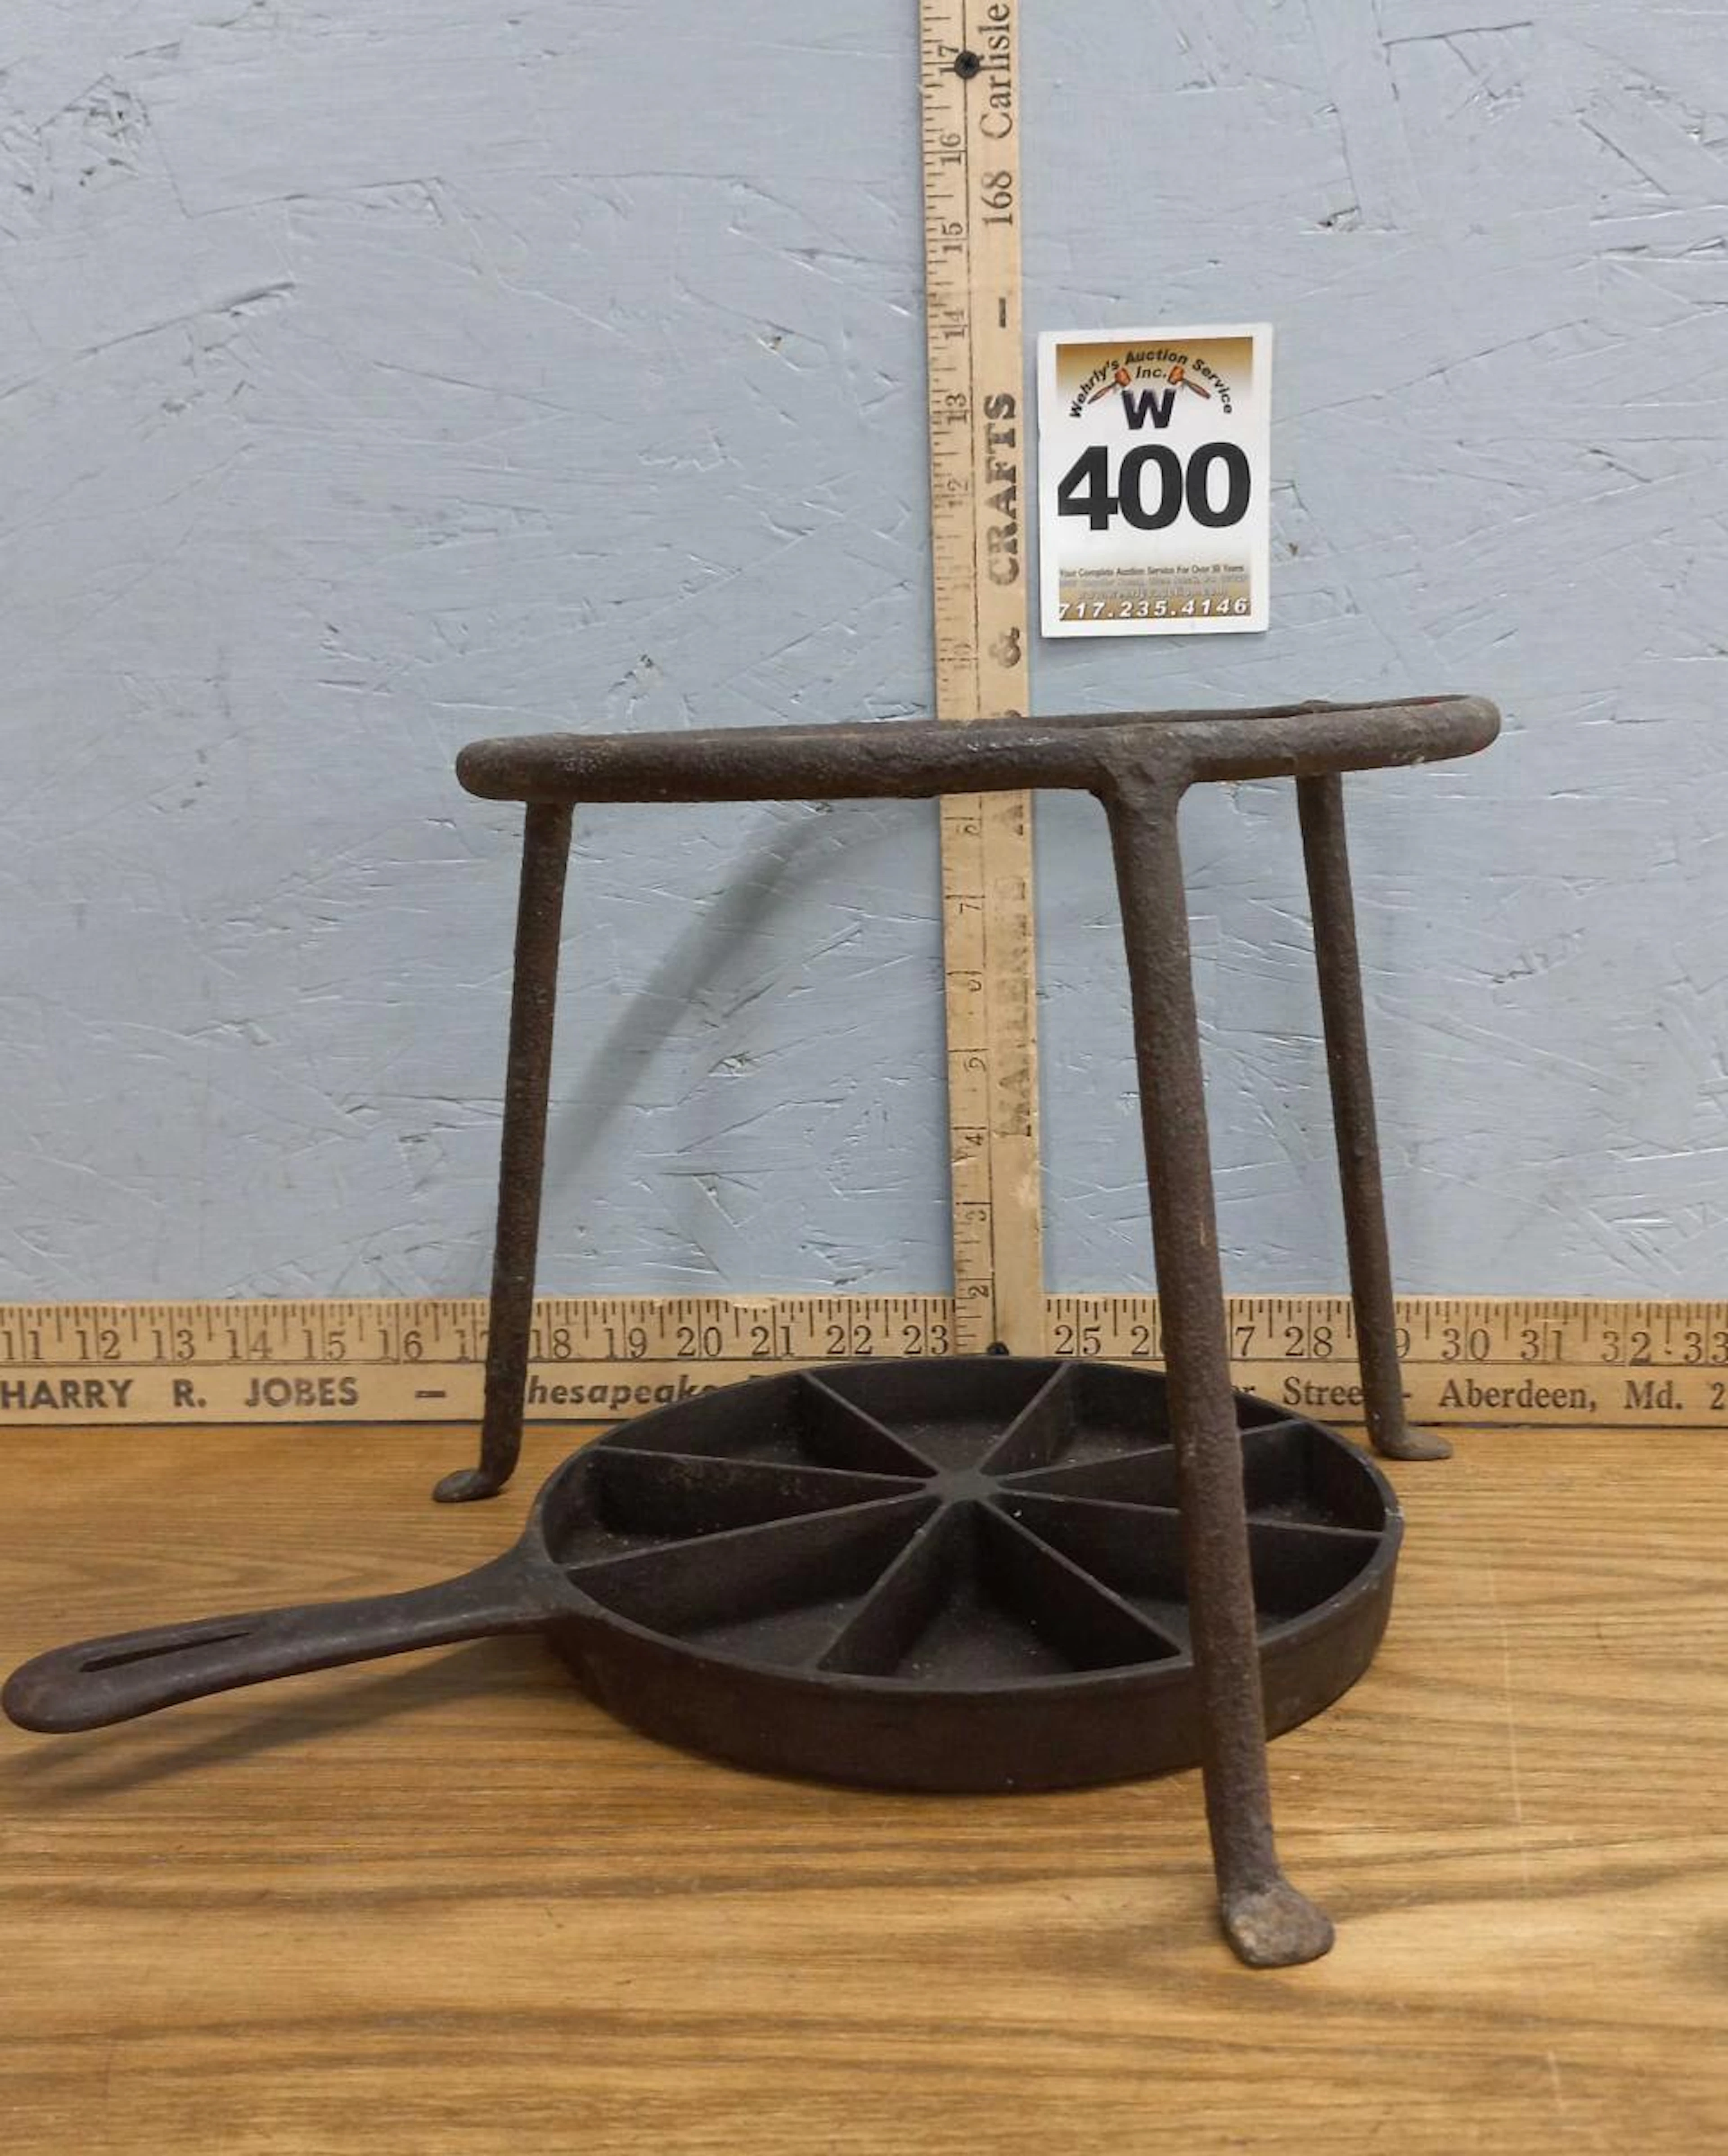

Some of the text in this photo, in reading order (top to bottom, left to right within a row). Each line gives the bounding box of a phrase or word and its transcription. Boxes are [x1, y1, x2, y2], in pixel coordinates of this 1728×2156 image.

[937, 45, 960, 76] 17
[978, 4, 1012, 139] Carlisle
[940, 133, 961, 166] 16
[981, 171, 1012, 226] 168
[942, 222, 963, 252] 15
[944, 310, 965, 339] 14
[1069, 349, 1232, 418] Wehrly's Auction Service
[1135, 365, 1167, 379] Inc.
[946, 393, 969, 425] 13
[1121, 388, 1176, 430] W
[947, 478, 968, 508] 12
[984, 393, 1020, 585] CRAFTS
[1058, 442, 1251, 530] 400
[1059, 598, 1248, 619] 717.235.4146
[959, 903, 982, 914] 7
[966, 1133, 983, 1145] 4
[969, 1285, 989, 1298] 2
[3, 1330, 44, 1360] 11
[76, 1330, 121, 1360] 12
[152, 1329, 195, 1361] 13
[226, 1330, 273, 1360] 14
[303, 1329, 346, 1361] 15
[377, 1330, 423, 1361] 16
[456, 1330, 489, 1361] 1
[531, 1328, 572, 1359] 18
[604, 1328, 647, 1358] 19
[677, 1326, 722, 1356] 20
[751, 1326, 795, 1355] 21
[827, 1325, 873, 1354] 22
[903, 1325, 948, 1355] 23
[1054, 1325, 1101, 1355] 25
[1285, 1326, 1333, 1356] 28
[1441, 1328, 1490, 1361] 30
[1521, 1329, 1565, 1361] 31
[1601, 1331, 1651, 1365] 32
[1684, 1331, 1728, 1364] 33
[1, 1379, 134, 1409] HARRY
[173, 1379, 207, 1408] R.
[245, 1377, 359, 1407] JOBES
[1283, 1376, 1363, 1406] Stree
[1438, 1378, 1596, 1412] Aberdeen,
[1624, 1380, 1683, 1410] Md.
